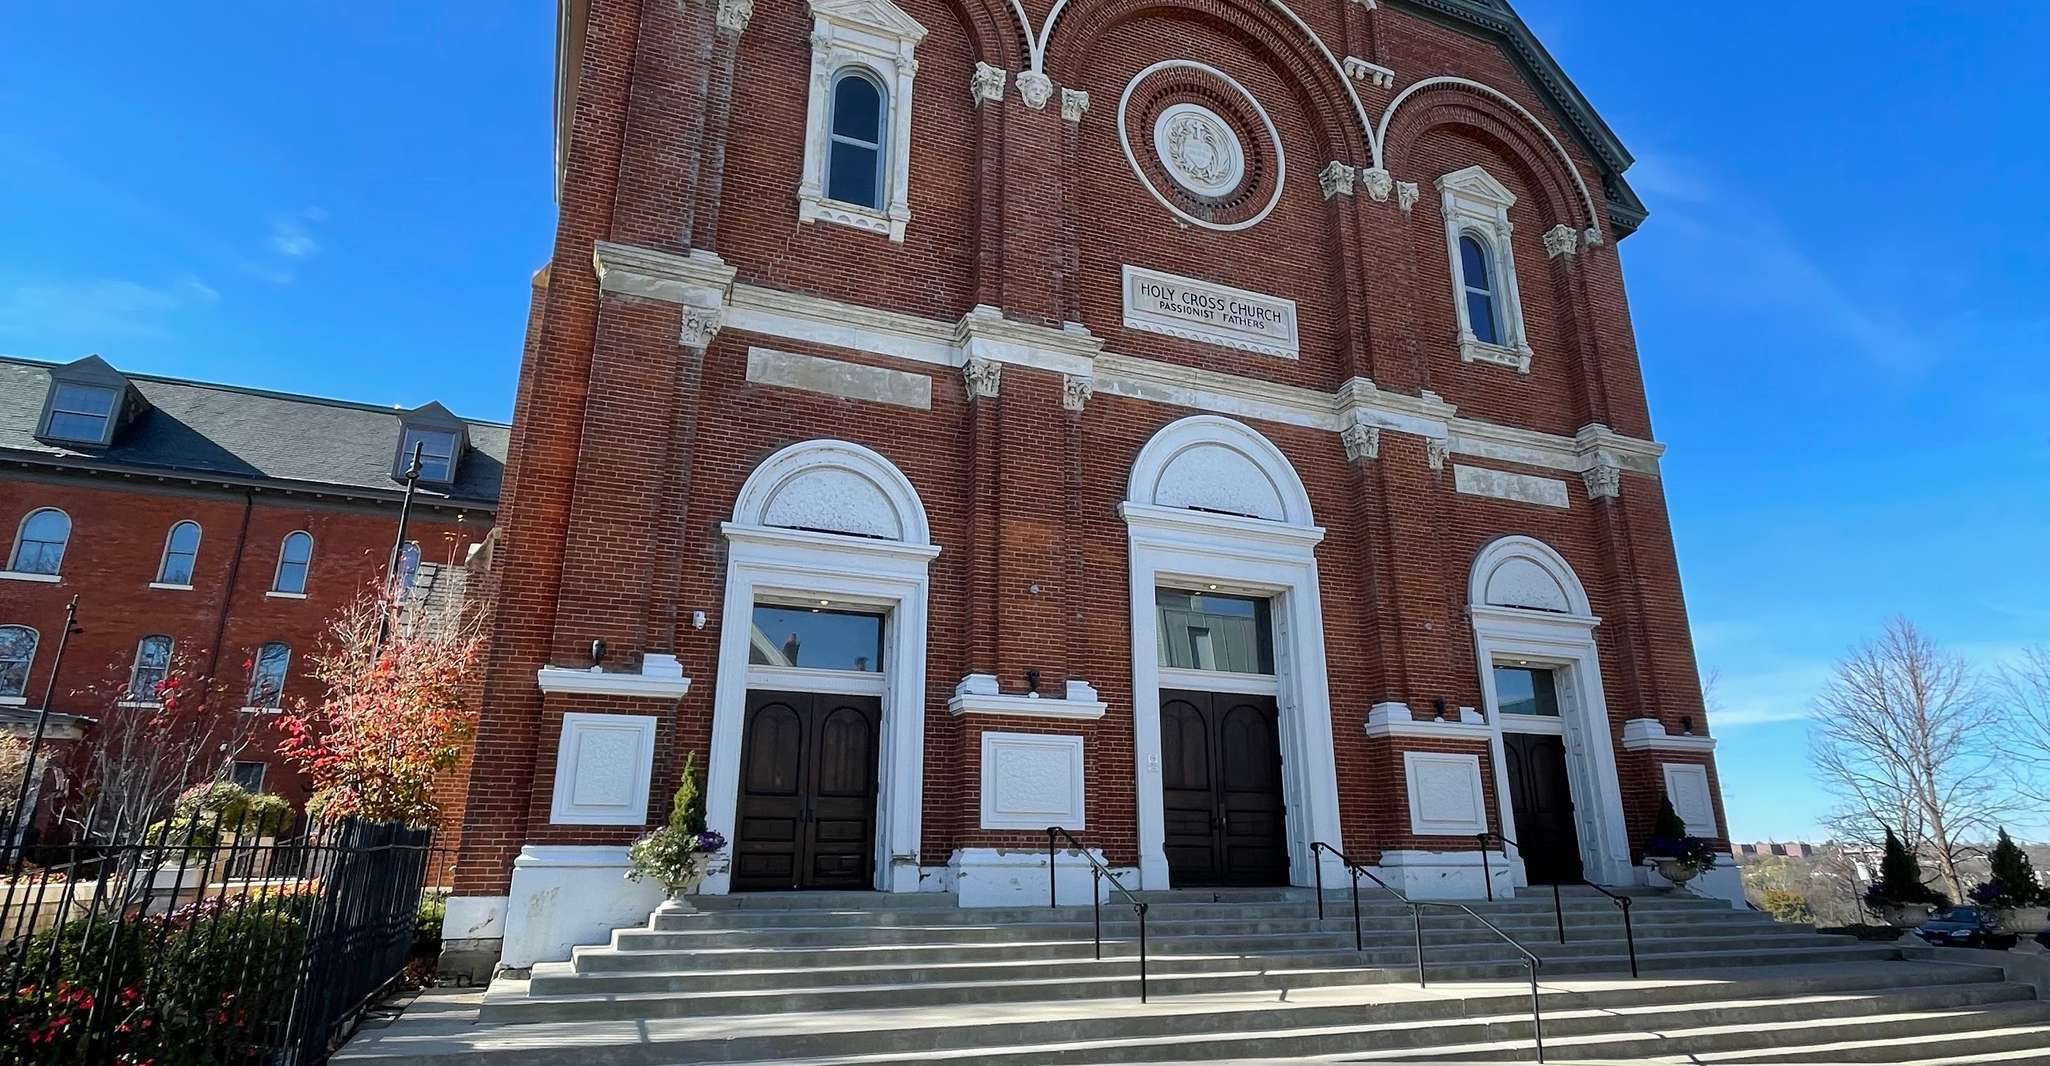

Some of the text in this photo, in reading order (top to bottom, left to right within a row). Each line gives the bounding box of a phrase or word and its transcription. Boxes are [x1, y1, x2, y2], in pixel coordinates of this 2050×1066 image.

[1141, 283, 1281, 323] HOLY CROSS CHURCH
[1160, 301, 1265, 329] PASSIONIST FATHERS
